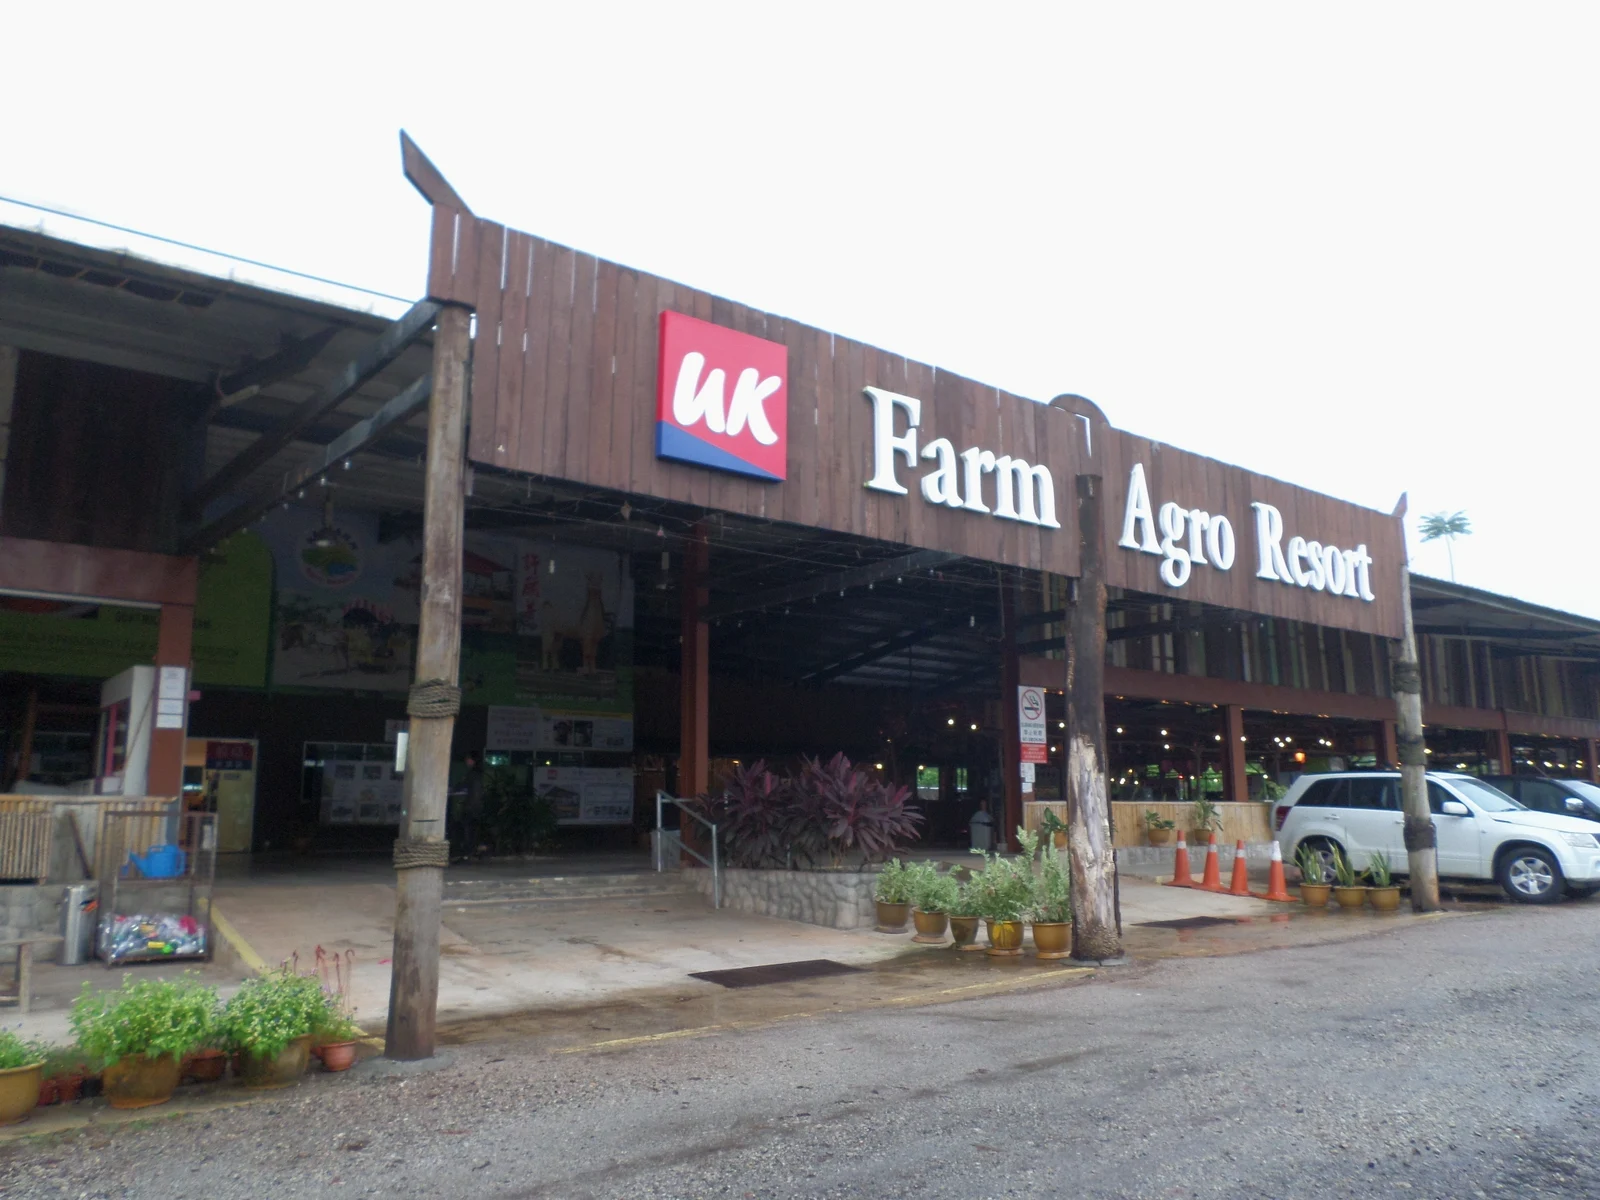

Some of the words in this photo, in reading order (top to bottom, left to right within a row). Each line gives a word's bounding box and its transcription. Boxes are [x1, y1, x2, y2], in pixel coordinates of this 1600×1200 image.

[862, 385, 1061, 529] Farm
[1118, 462, 1236, 588] Agro
[1250, 501, 1375, 602] Resort
